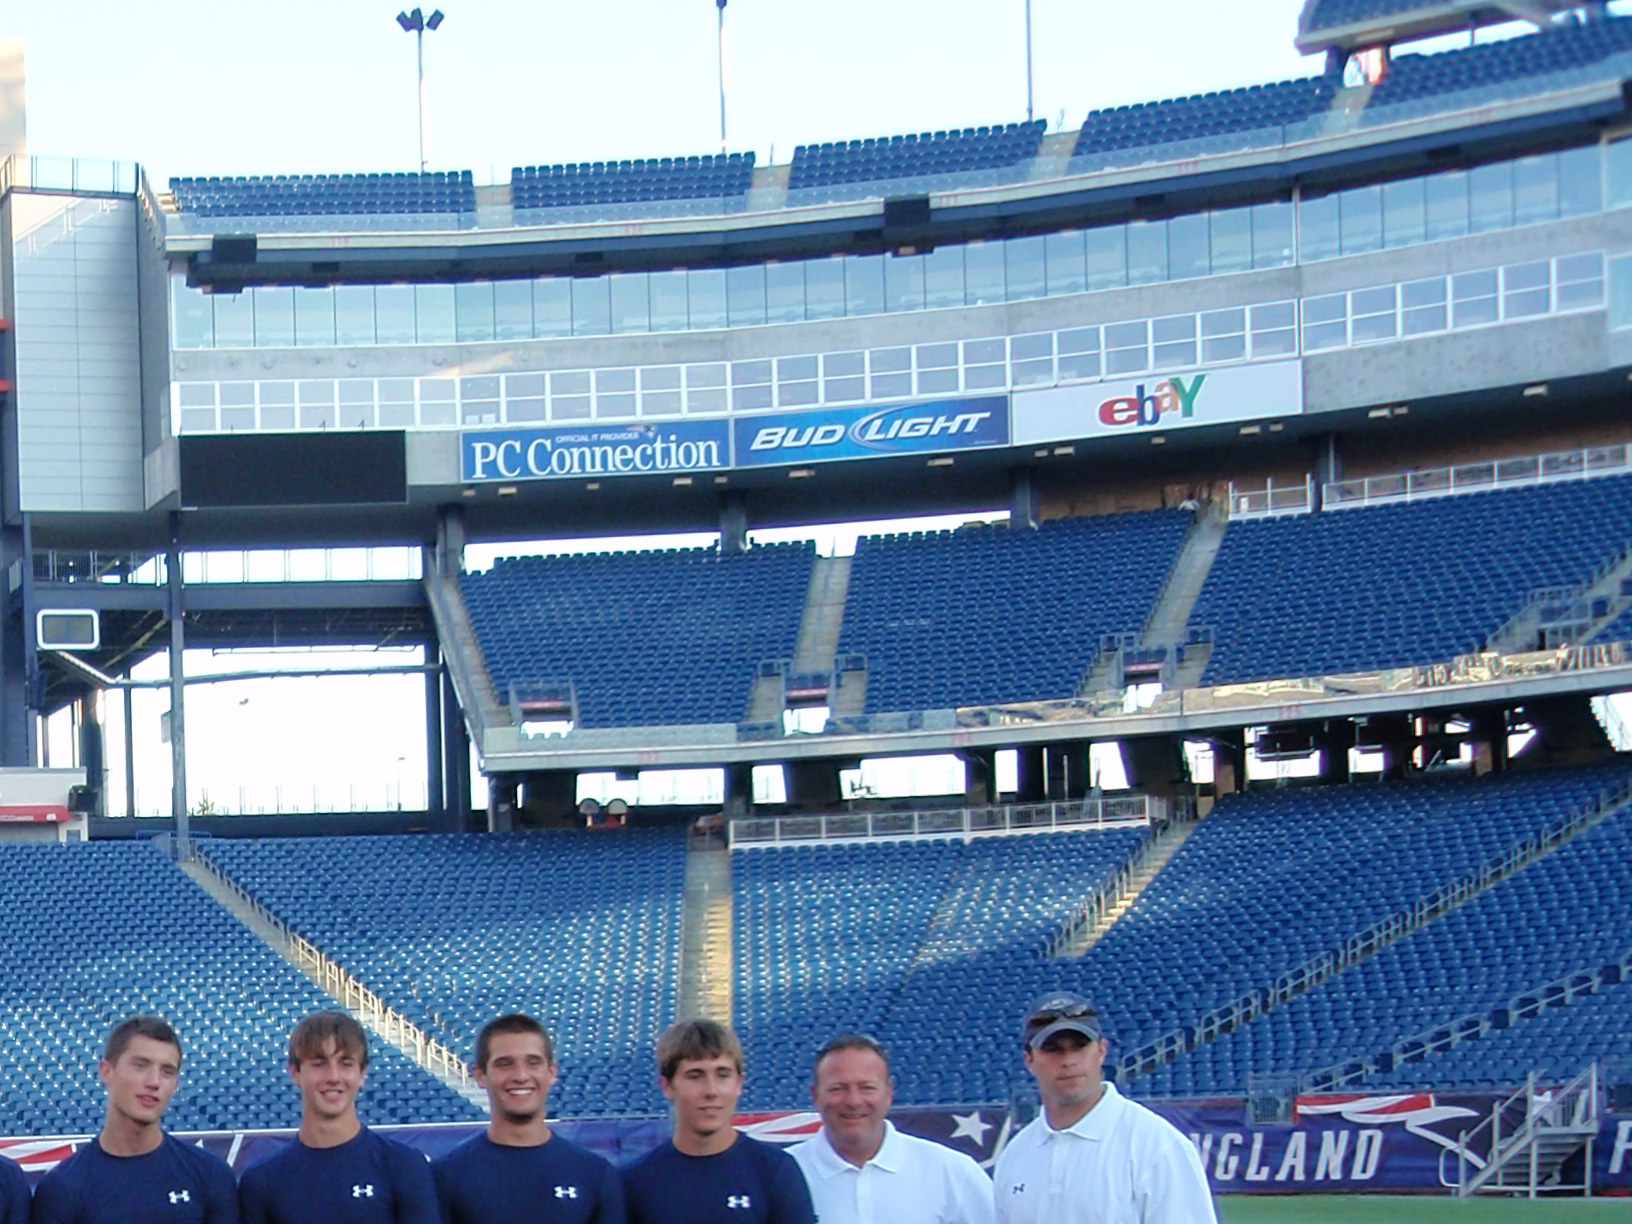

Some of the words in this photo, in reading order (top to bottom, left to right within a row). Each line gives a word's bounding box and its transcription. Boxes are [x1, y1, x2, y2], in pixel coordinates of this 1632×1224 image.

[749, 422, 847, 451] BUD
[864, 411, 992, 441] LIGHT
[471, 440, 521, 479] PC
[527, 434, 721, 476] Connection
[1188, 1130, 1384, 1182] NGLAND
